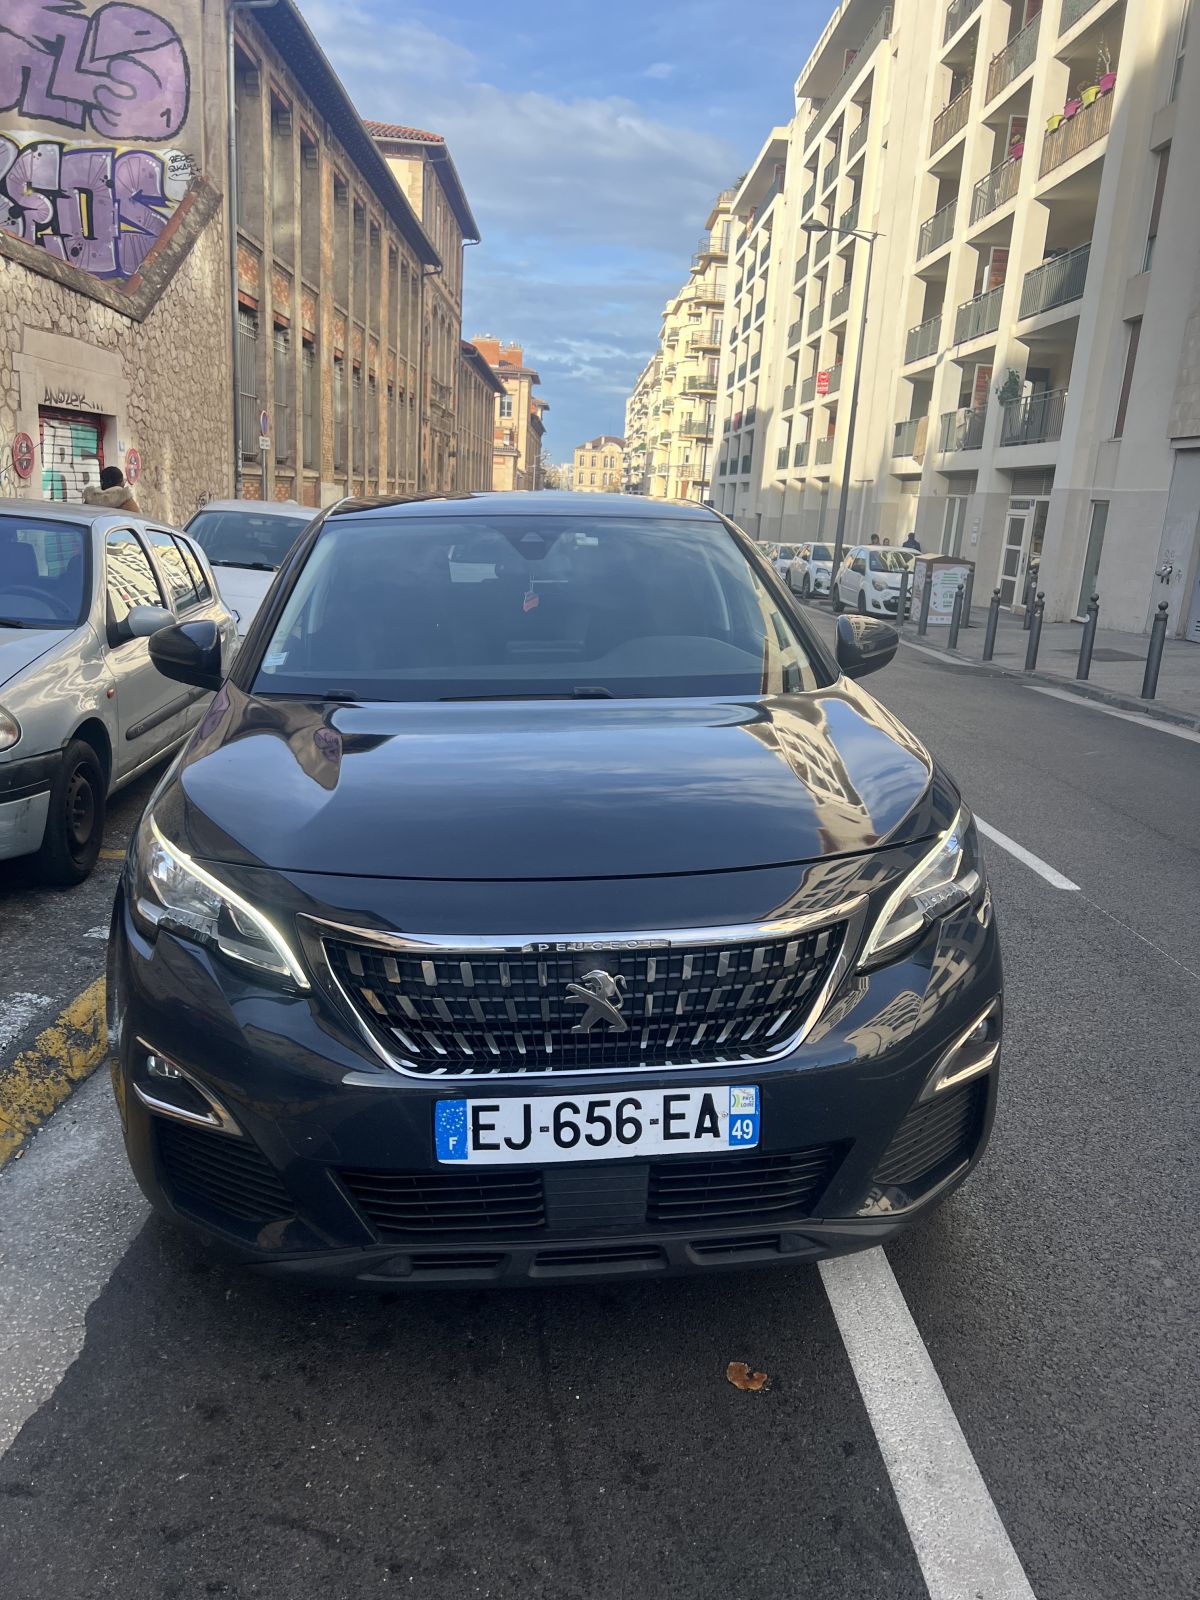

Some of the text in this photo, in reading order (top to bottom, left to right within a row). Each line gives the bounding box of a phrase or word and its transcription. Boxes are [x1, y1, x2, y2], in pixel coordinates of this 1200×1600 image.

[472, 1093, 721, 1151] EJ-656-EA
[731, 1119, 754, 1140] 49
[449, 1137, 458, 1150] F
